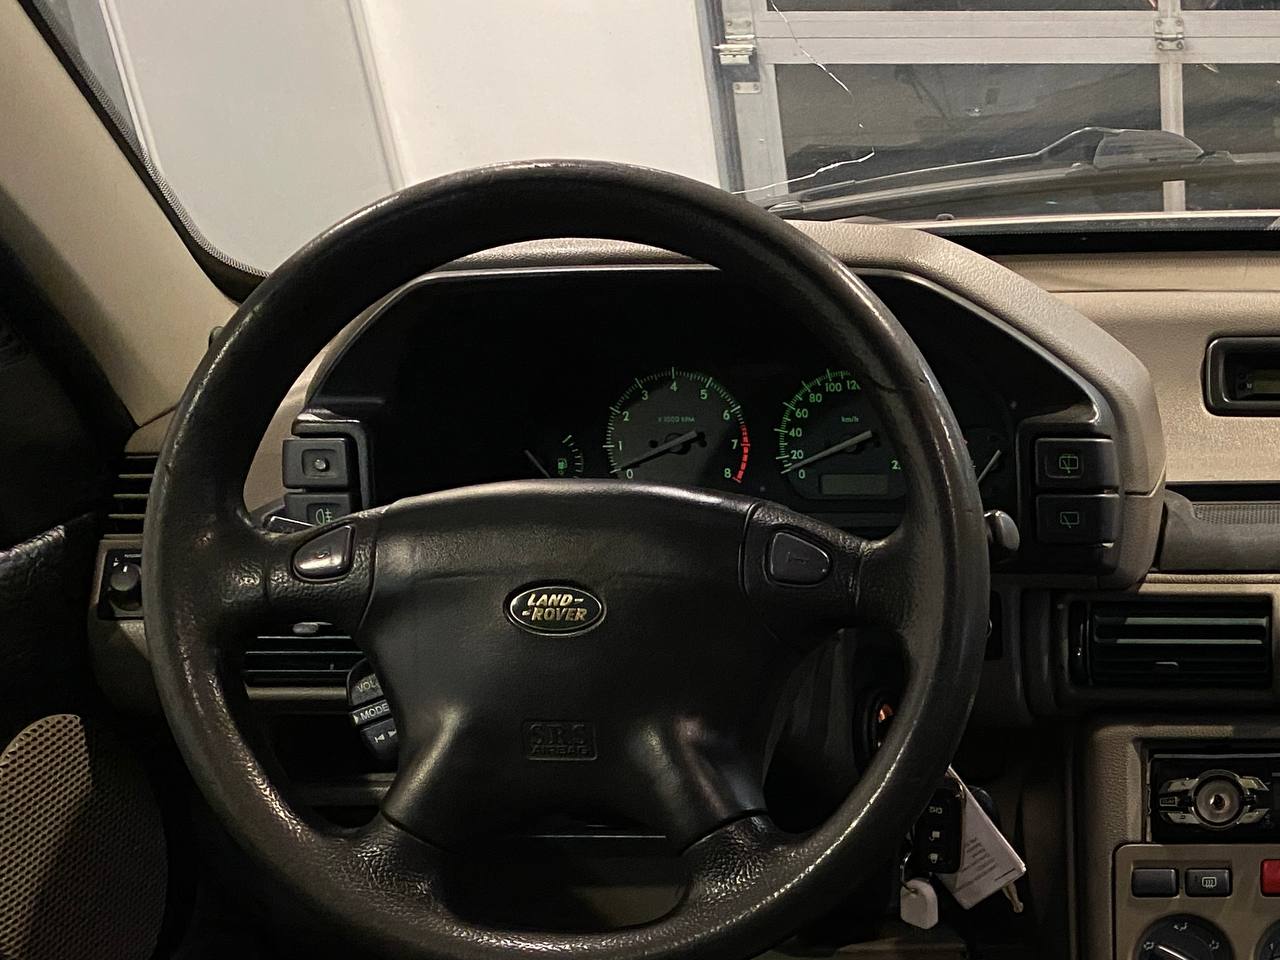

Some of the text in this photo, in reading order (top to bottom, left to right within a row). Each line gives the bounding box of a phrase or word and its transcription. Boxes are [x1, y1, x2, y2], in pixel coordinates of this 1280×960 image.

[669, 380, 678, 392] 4
[824, 382, 843, 393] 100
[641, 389, 649, 401] 3
[699, 389, 708, 400] 5
[808, 393, 823, 403] 80
[622, 410, 630, 422] 2
[722, 410, 731, 421] 6
[795, 408, 809, 419] 60
[788, 427, 803, 438] 40
[618, 440, 622, 452] 1
[730, 438, 739, 450] 7
[790, 449, 804, 460] 20
[626, 468, 634, 479] 0
[723, 467, 732, 479] 8
[798, 468, 806, 479] 0
[359, 702, 390, 721] MODE
[529, 723, 586, 745] SRS
